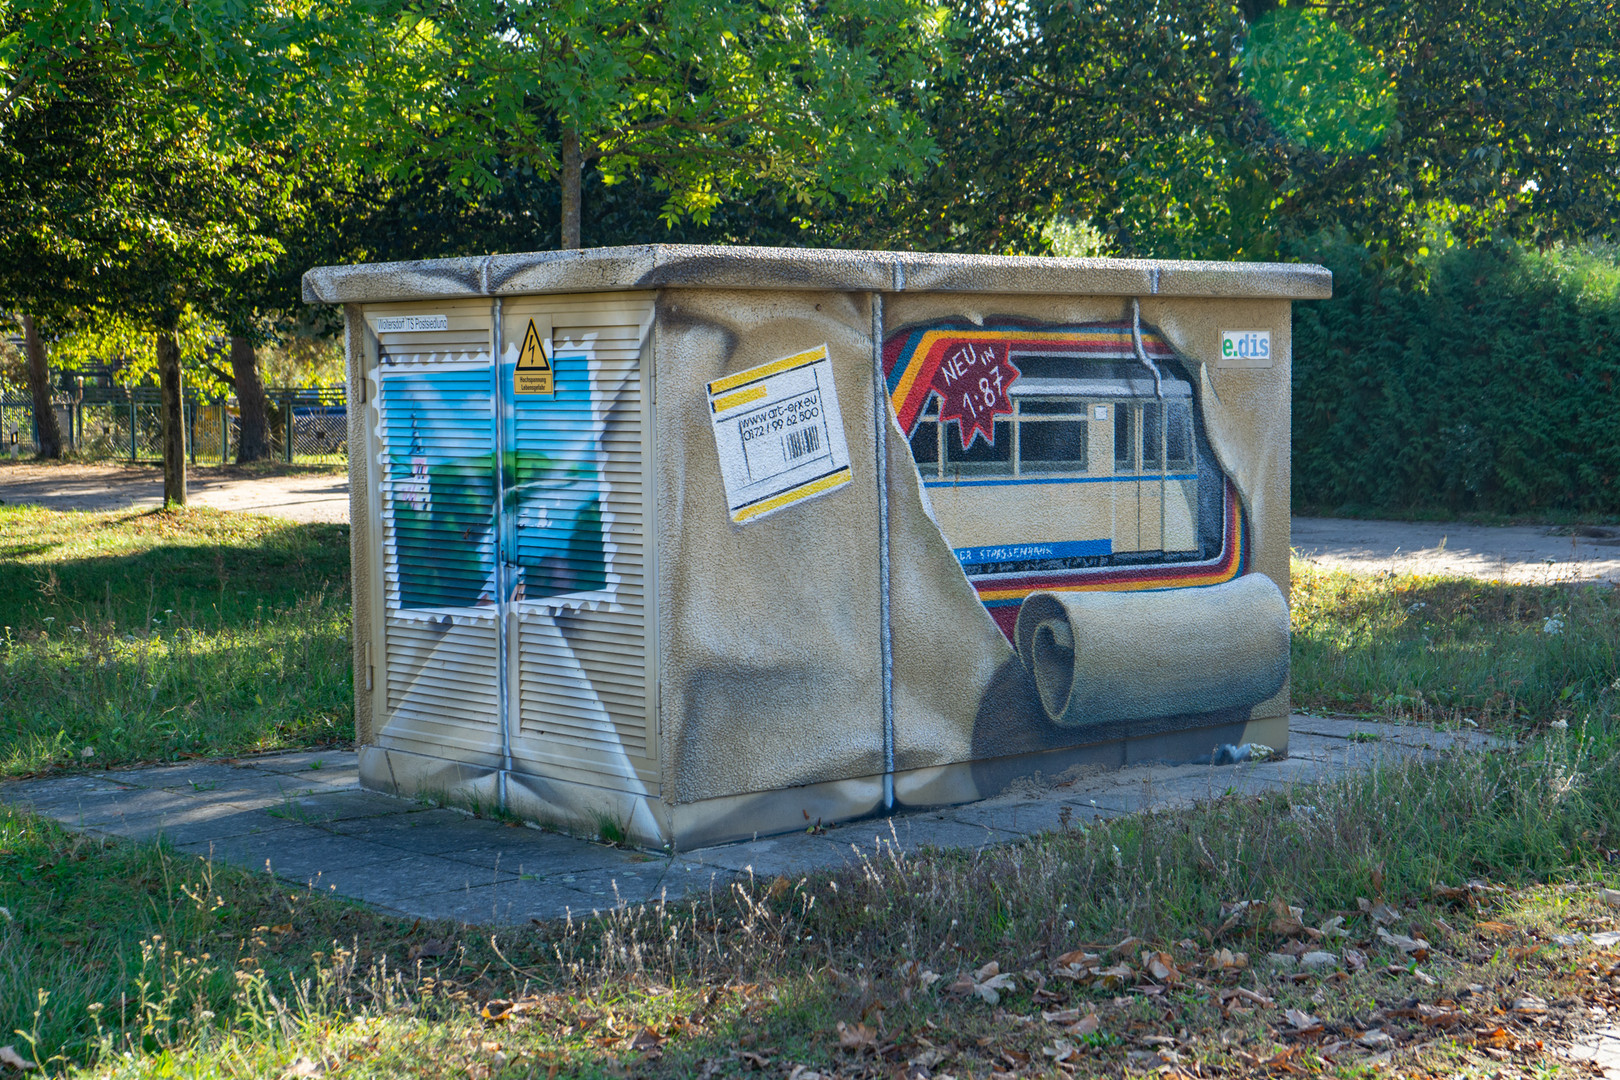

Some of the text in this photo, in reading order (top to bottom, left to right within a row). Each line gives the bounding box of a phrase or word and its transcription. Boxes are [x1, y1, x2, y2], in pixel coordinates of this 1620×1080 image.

[406, 317, 415, 330] TS
[415, 317, 447, 329] Postsiedlung
[1222, 334, 1269, 357] e.dis
[942, 343, 995, 386] NEU IN
[521, 384, 546, 392] Lebensgefahr
[963, 366, 1003, 418] 1:87
[743, 426, 764, 441] 0172
[771, 419, 784, 431] 99
[787, 415, 797, 426] 62
[799, 407, 819, 421] 500
